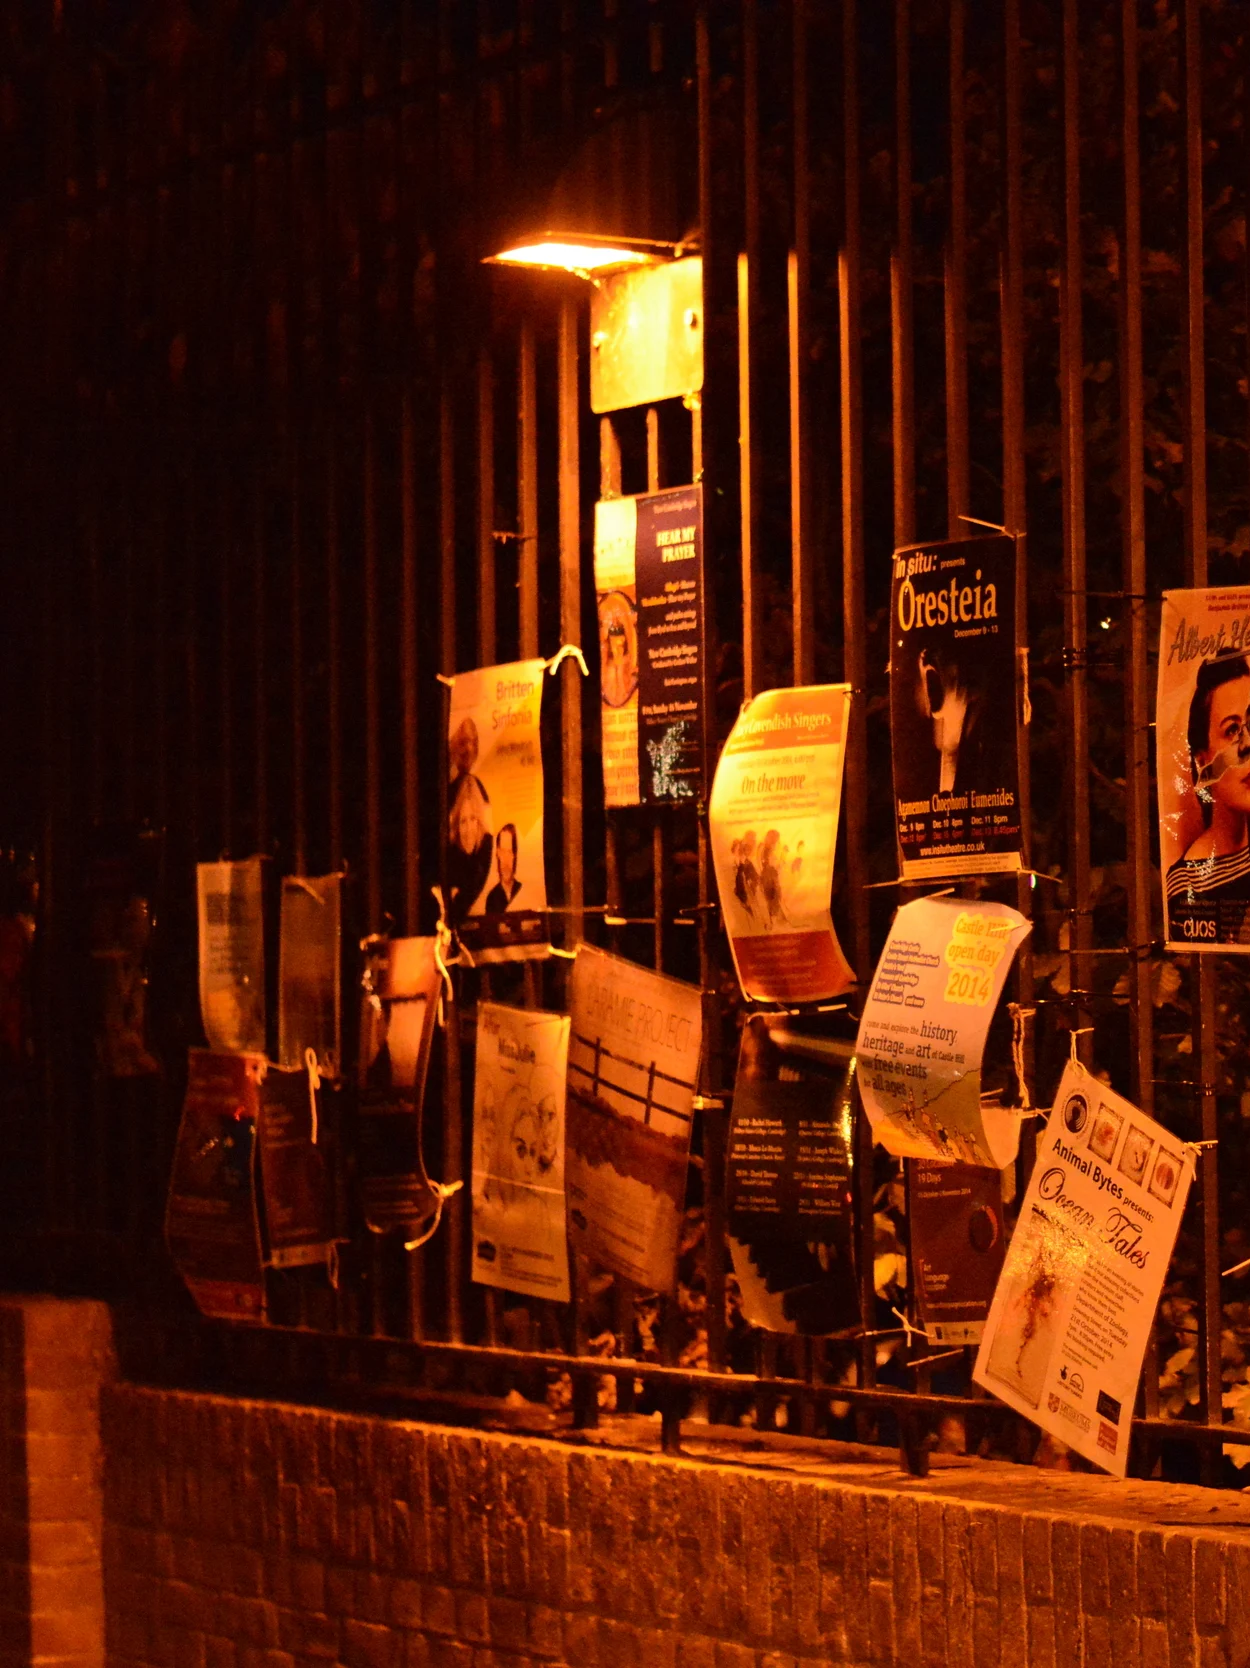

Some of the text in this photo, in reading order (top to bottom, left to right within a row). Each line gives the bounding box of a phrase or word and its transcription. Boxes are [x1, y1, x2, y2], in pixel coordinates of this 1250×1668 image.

[656, 525, 696, 547] HEAR MY
[661, 543, 696, 563] PRAYER
[898, 568, 998, 632] Oresteia
[1168, 617, 1226, 666] Albert
[496, 680, 534, 701] Britten
[492, 705, 533, 730] Sinfonia
[793, 711, 832, 732] Singers
[741, 772, 806, 795] On the move
[970, 788, 1014, 808] Eumenides
[956, 918, 983, 938] Castle
[948, 944, 1001, 968] open day
[947, 972, 992, 1001] 2014
[636, 1002, 692, 1053] PROJECT
[862, 1032, 905, 1058] heritage
[916, 1045, 932, 1060] art
[874, 1054, 894, 1072] free
[894, 1062, 928, 1080] events
[872, 1074, 885, 1092] all
[885, 1081, 907, 1098] ages
[928, 1172, 942, 1185] Days
[1052, 1138, 1155, 1224] Animal Bytes presents:
[1038, 1166, 1151, 1270] Ocean Tales
[1076, 1294, 1104, 1318] Department
